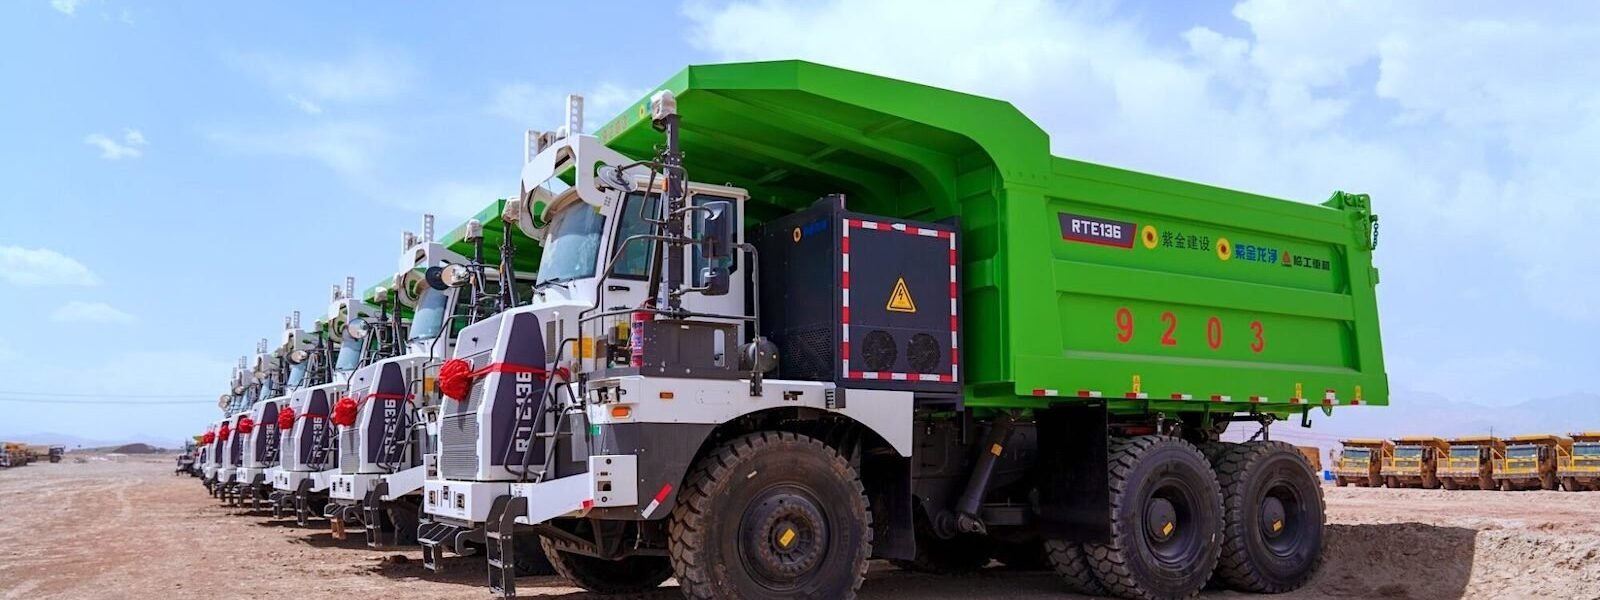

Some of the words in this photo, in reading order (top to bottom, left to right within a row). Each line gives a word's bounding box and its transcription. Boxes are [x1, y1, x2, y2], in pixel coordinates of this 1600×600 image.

[1071, 219, 1122, 240] RTE136
[1162, 231, 1210, 252] 紫金建设
